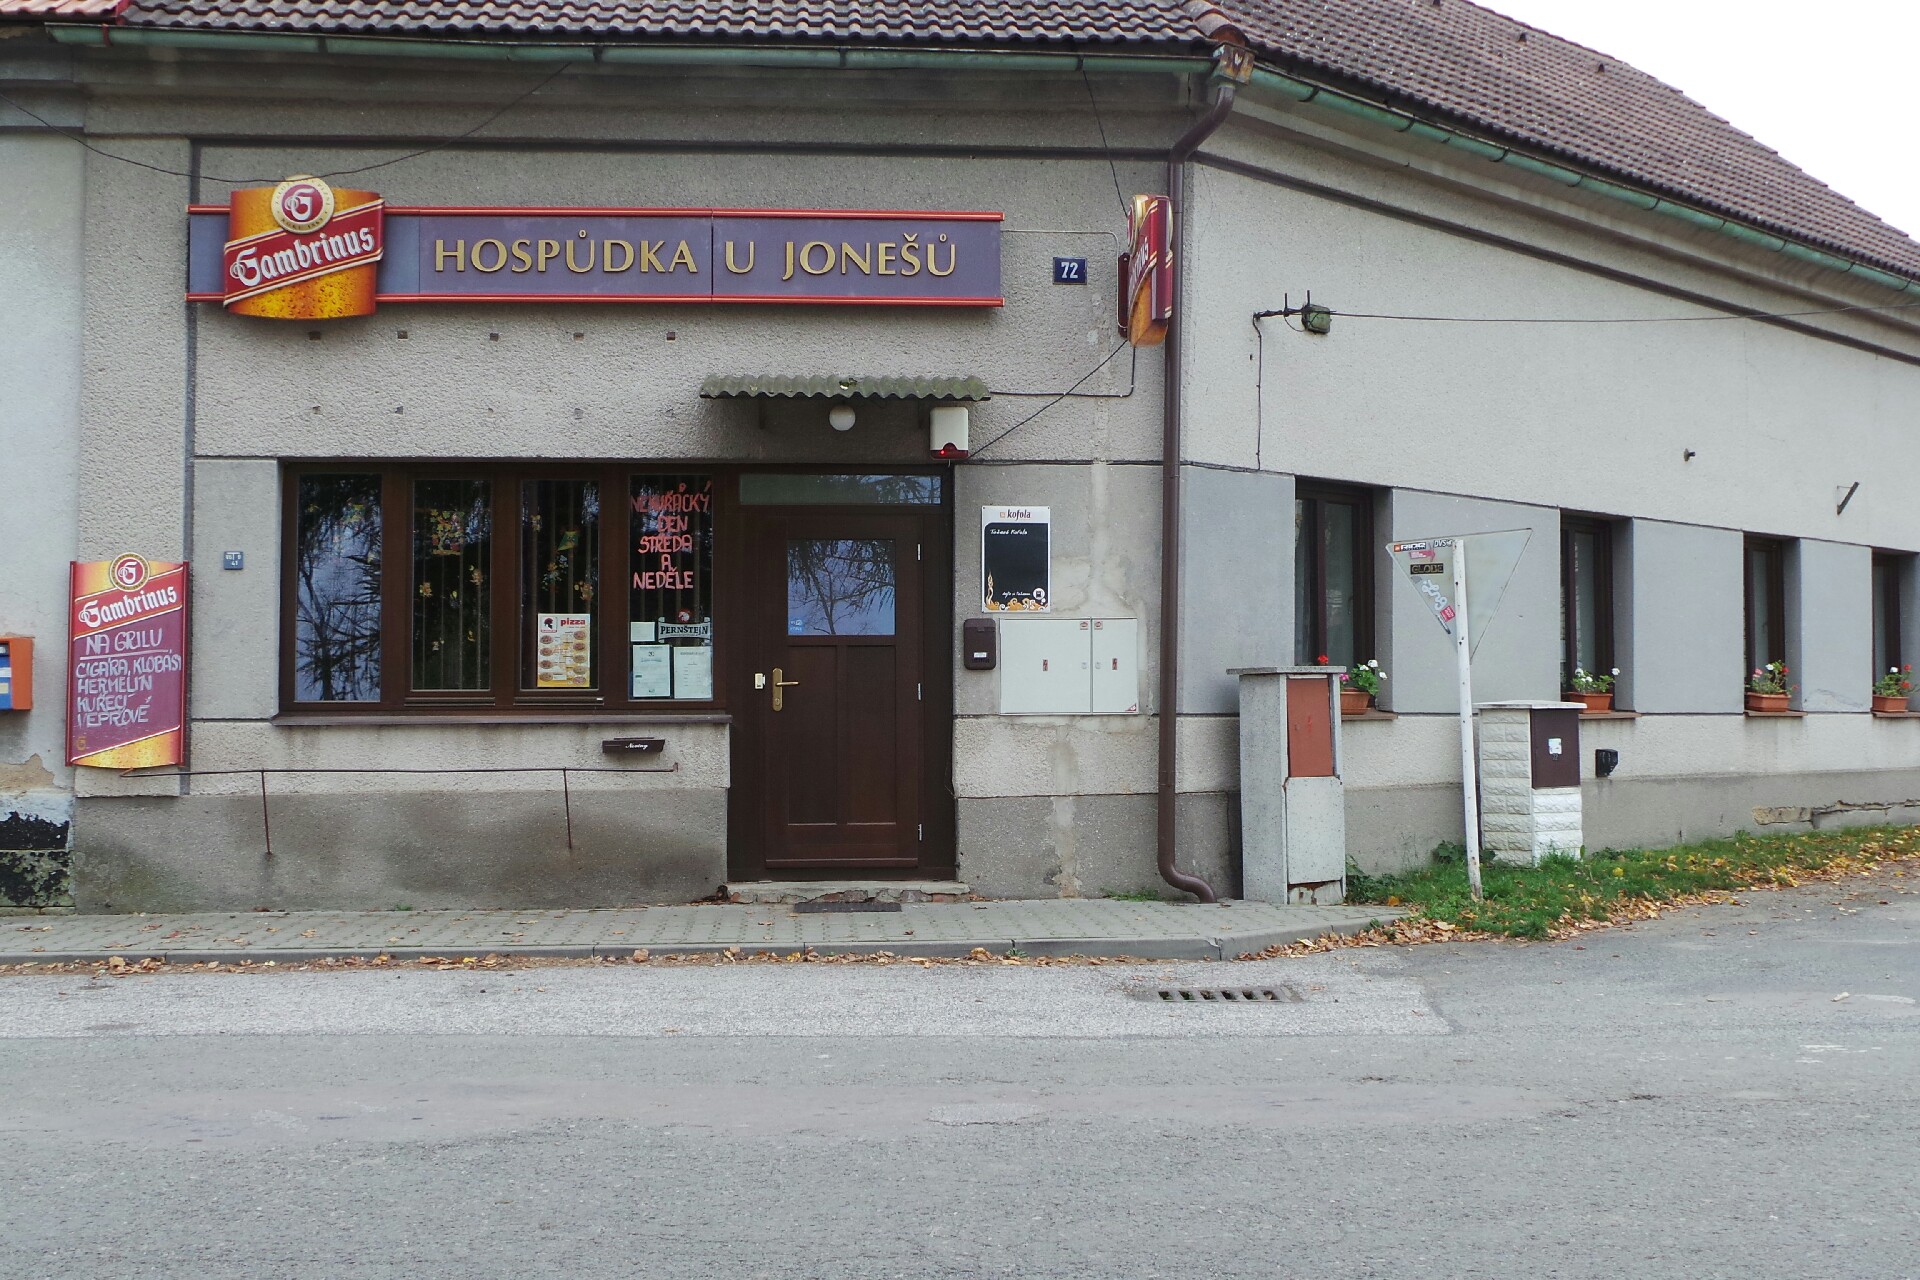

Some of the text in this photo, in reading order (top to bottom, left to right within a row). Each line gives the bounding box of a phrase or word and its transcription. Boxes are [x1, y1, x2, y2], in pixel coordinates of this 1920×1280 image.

[229, 226, 376, 287] Gambrinus
[435, 230, 956, 281] HOSPŮDKA U JONEŠŮ
[1061, 262, 1078, 279] 72
[658, 515, 688, 532] DEN
[1007, 509, 1031, 521] kofola
[661, 553, 671, 572] A
[633, 567, 693, 590] NEDĚLE
[78, 586, 177, 628] Gambrinus
[561, 618, 585, 626] pizza
[86, 628, 163, 655] NA GRILU
